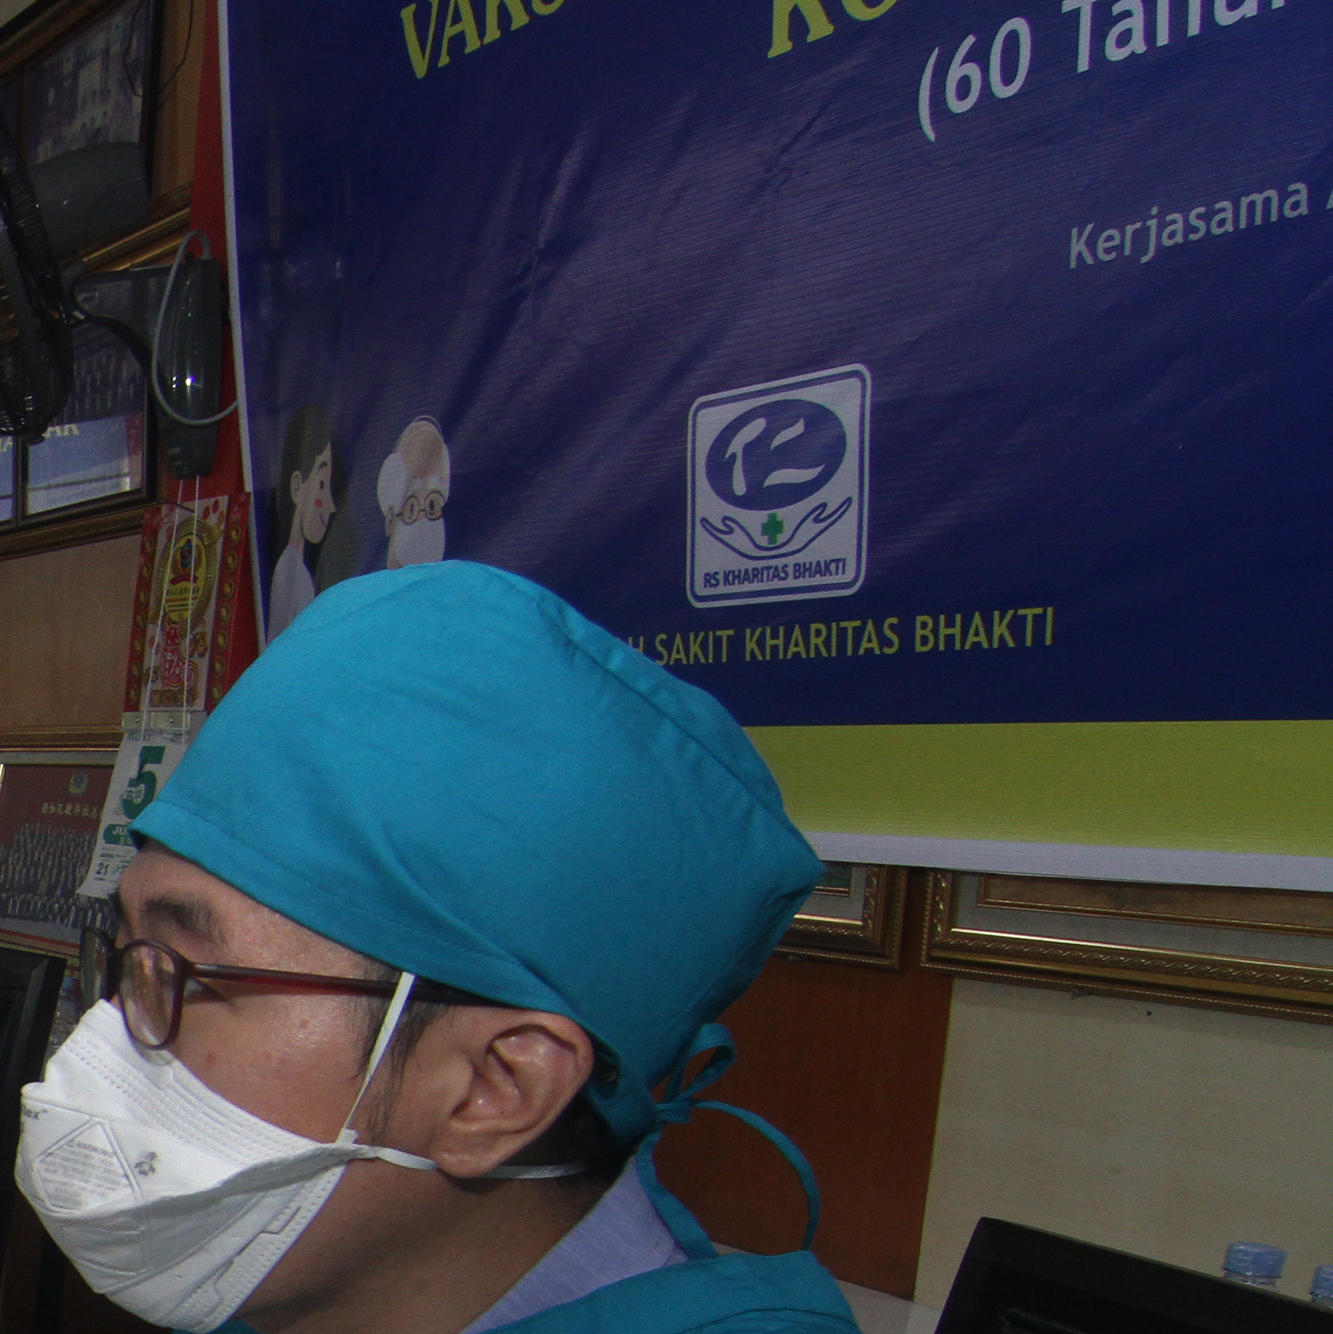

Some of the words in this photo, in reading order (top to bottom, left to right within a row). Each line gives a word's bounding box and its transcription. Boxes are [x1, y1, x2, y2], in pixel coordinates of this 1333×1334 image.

[918, 17, 1032, 141] (60
[1069, 182, 1309, 269] Kerjasama
[703, 572, 721, 589] RS
[722, 564, 789, 587] KHARITAS
[793, 558, 847, 581] BHAKTI
[654, 629, 735, 666] SAKIT
[744, 615, 901, 662] KHARITAS
[914, 606, 1055, 653] BHAKTI
[122, 746, 166, 820] 5
